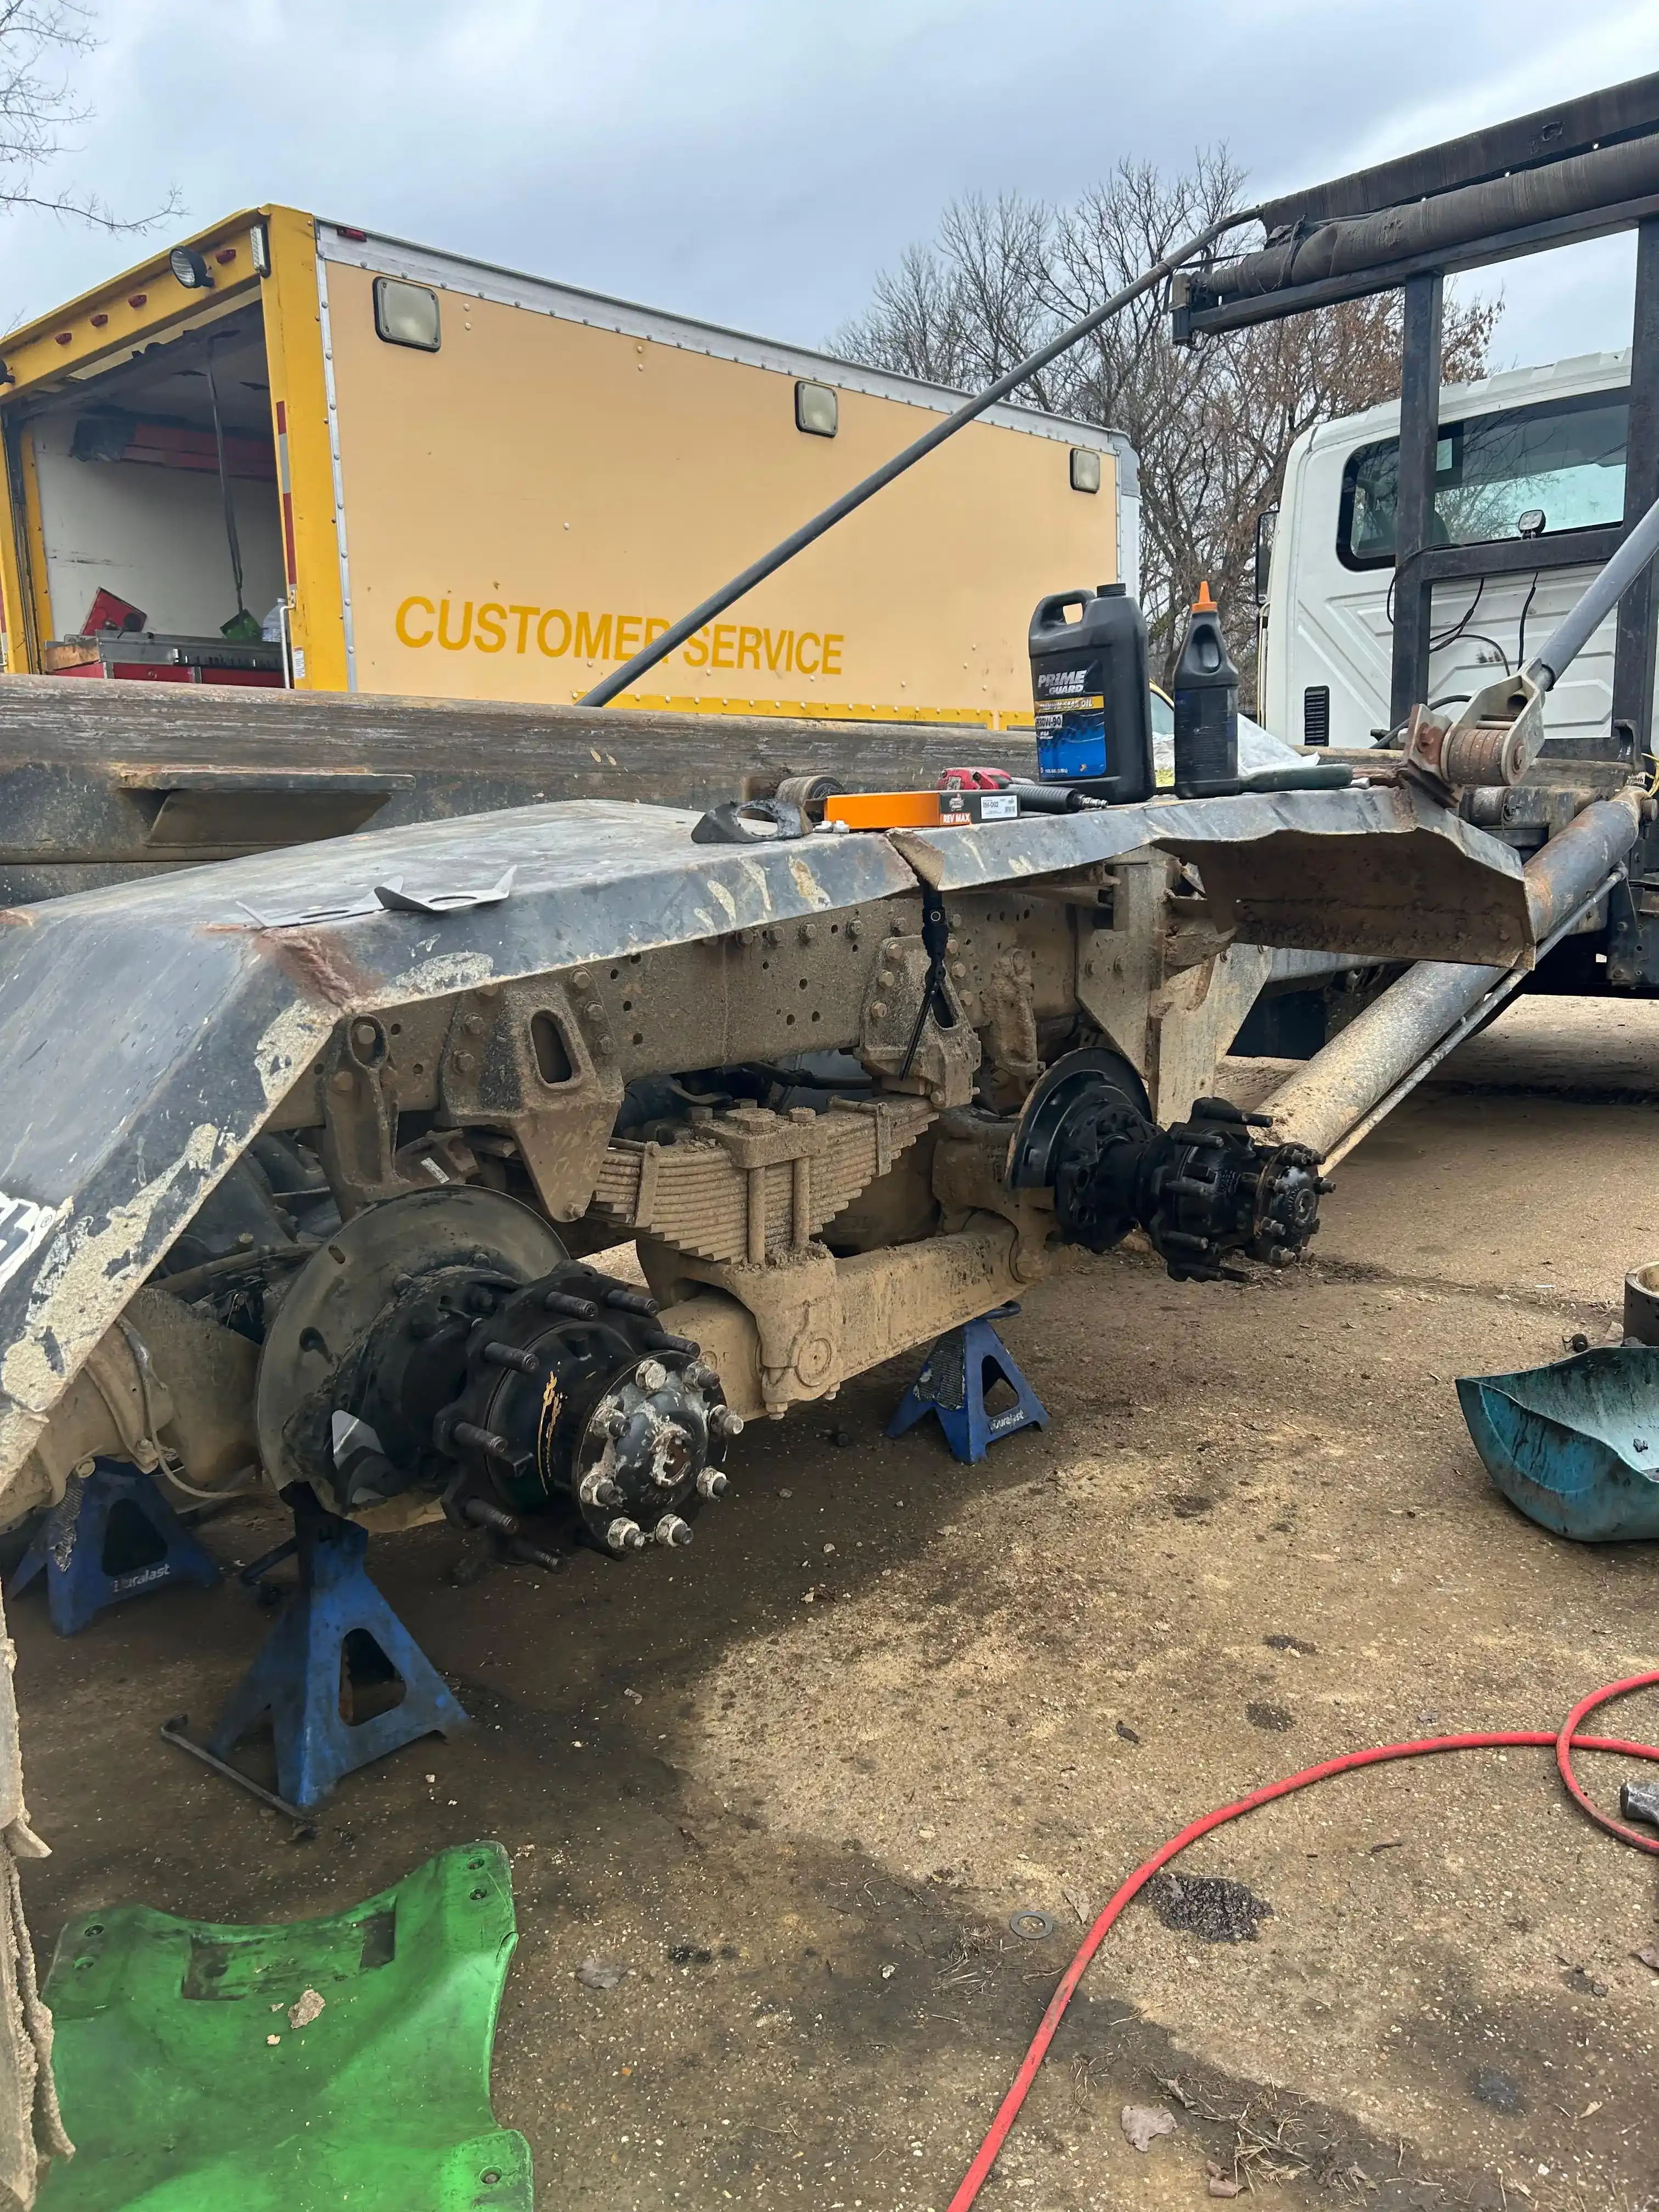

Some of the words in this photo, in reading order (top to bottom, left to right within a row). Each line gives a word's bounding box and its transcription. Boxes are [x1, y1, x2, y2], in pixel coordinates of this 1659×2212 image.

[683, 624, 844, 675] SERVICE
[1037, 670, 1087, 687] PRIME
[1049, 684, 1084, 695] GUARD
[1081, 699, 1093, 707] OIL
[943, 814, 955, 823] REV
[955, 812, 970, 823] MAX
